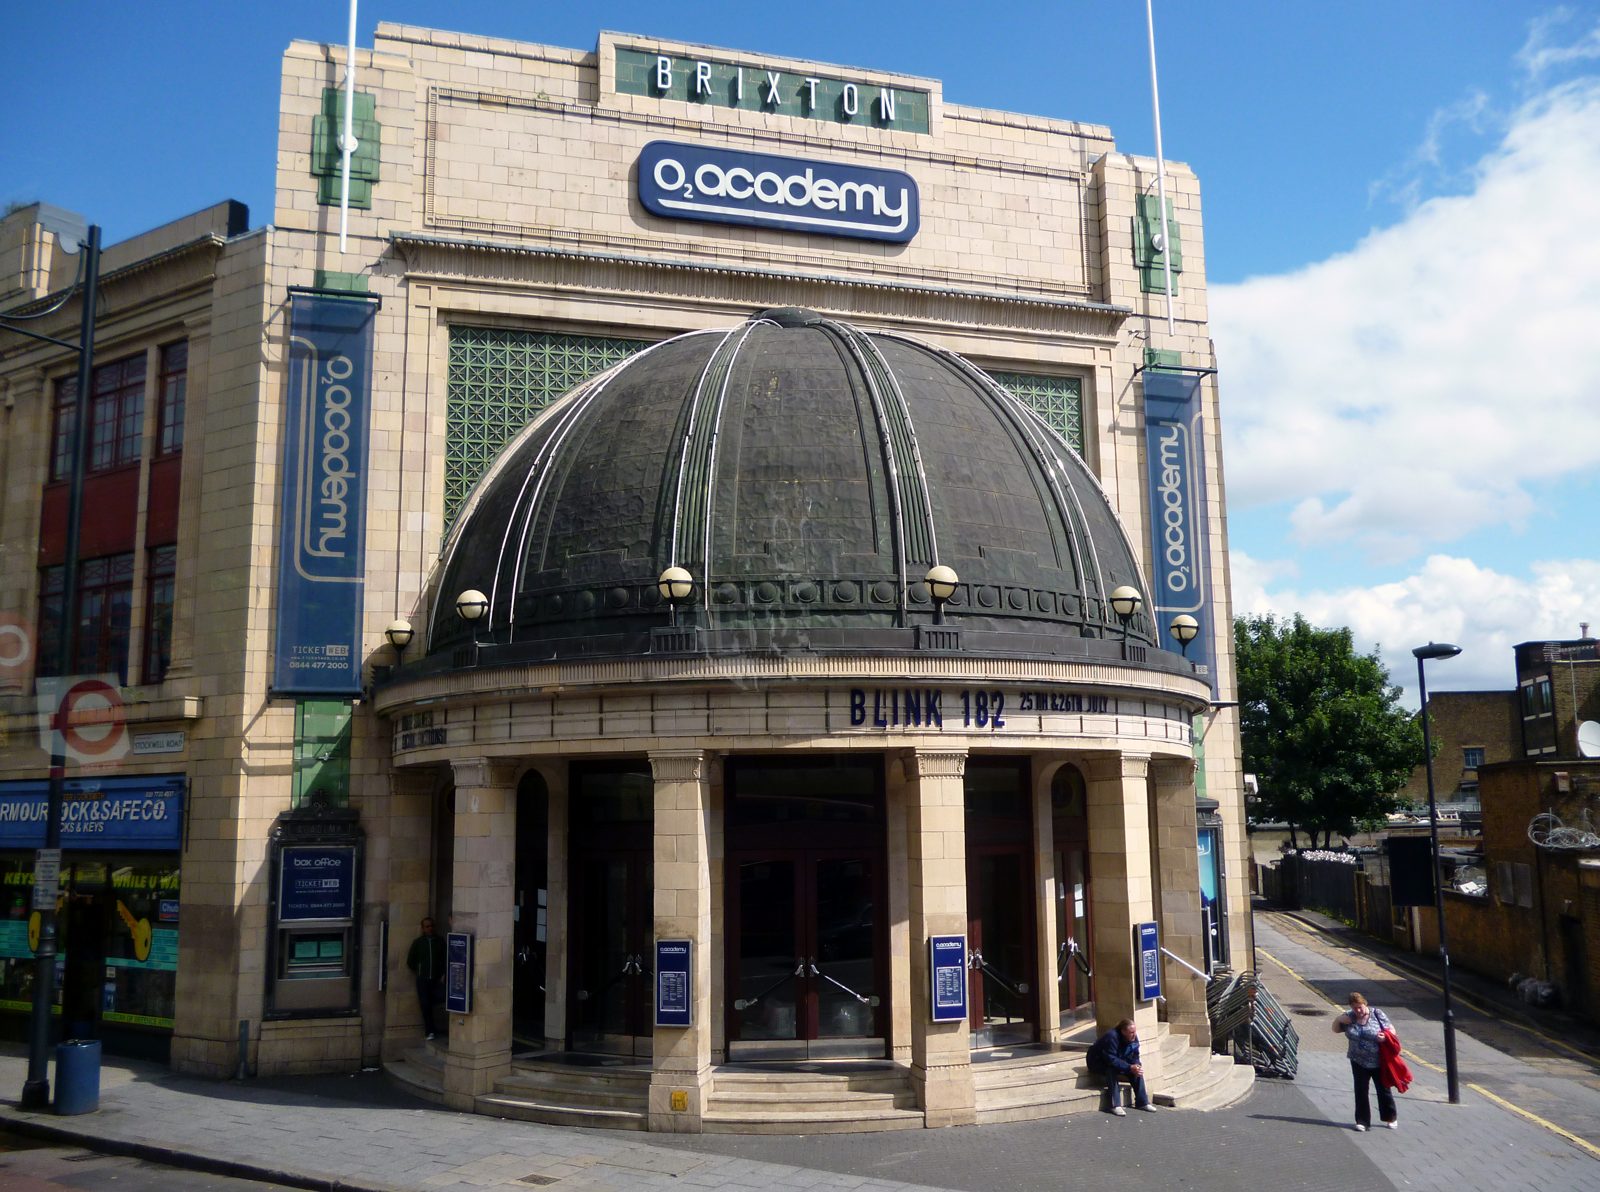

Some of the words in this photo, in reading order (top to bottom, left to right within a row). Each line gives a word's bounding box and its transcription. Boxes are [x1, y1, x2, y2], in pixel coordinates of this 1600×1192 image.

[656, 56, 895, 121] BRIXTON
[850, 688, 943, 728] BLINK
[960, 689, 1006, 728] 182
[1087, 694, 1109, 713] JULY
[166, 739, 183, 748] ROAD
[75, 821, 82, 833] &
[82, 821, 105, 833] KEYS
[294, 858, 312, 867] box
[314, 857, 341, 867] office
[3, 872, 35, 885] KEYS
[112, 874, 147, 888] WHILE
[149, 875, 157, 888] U
